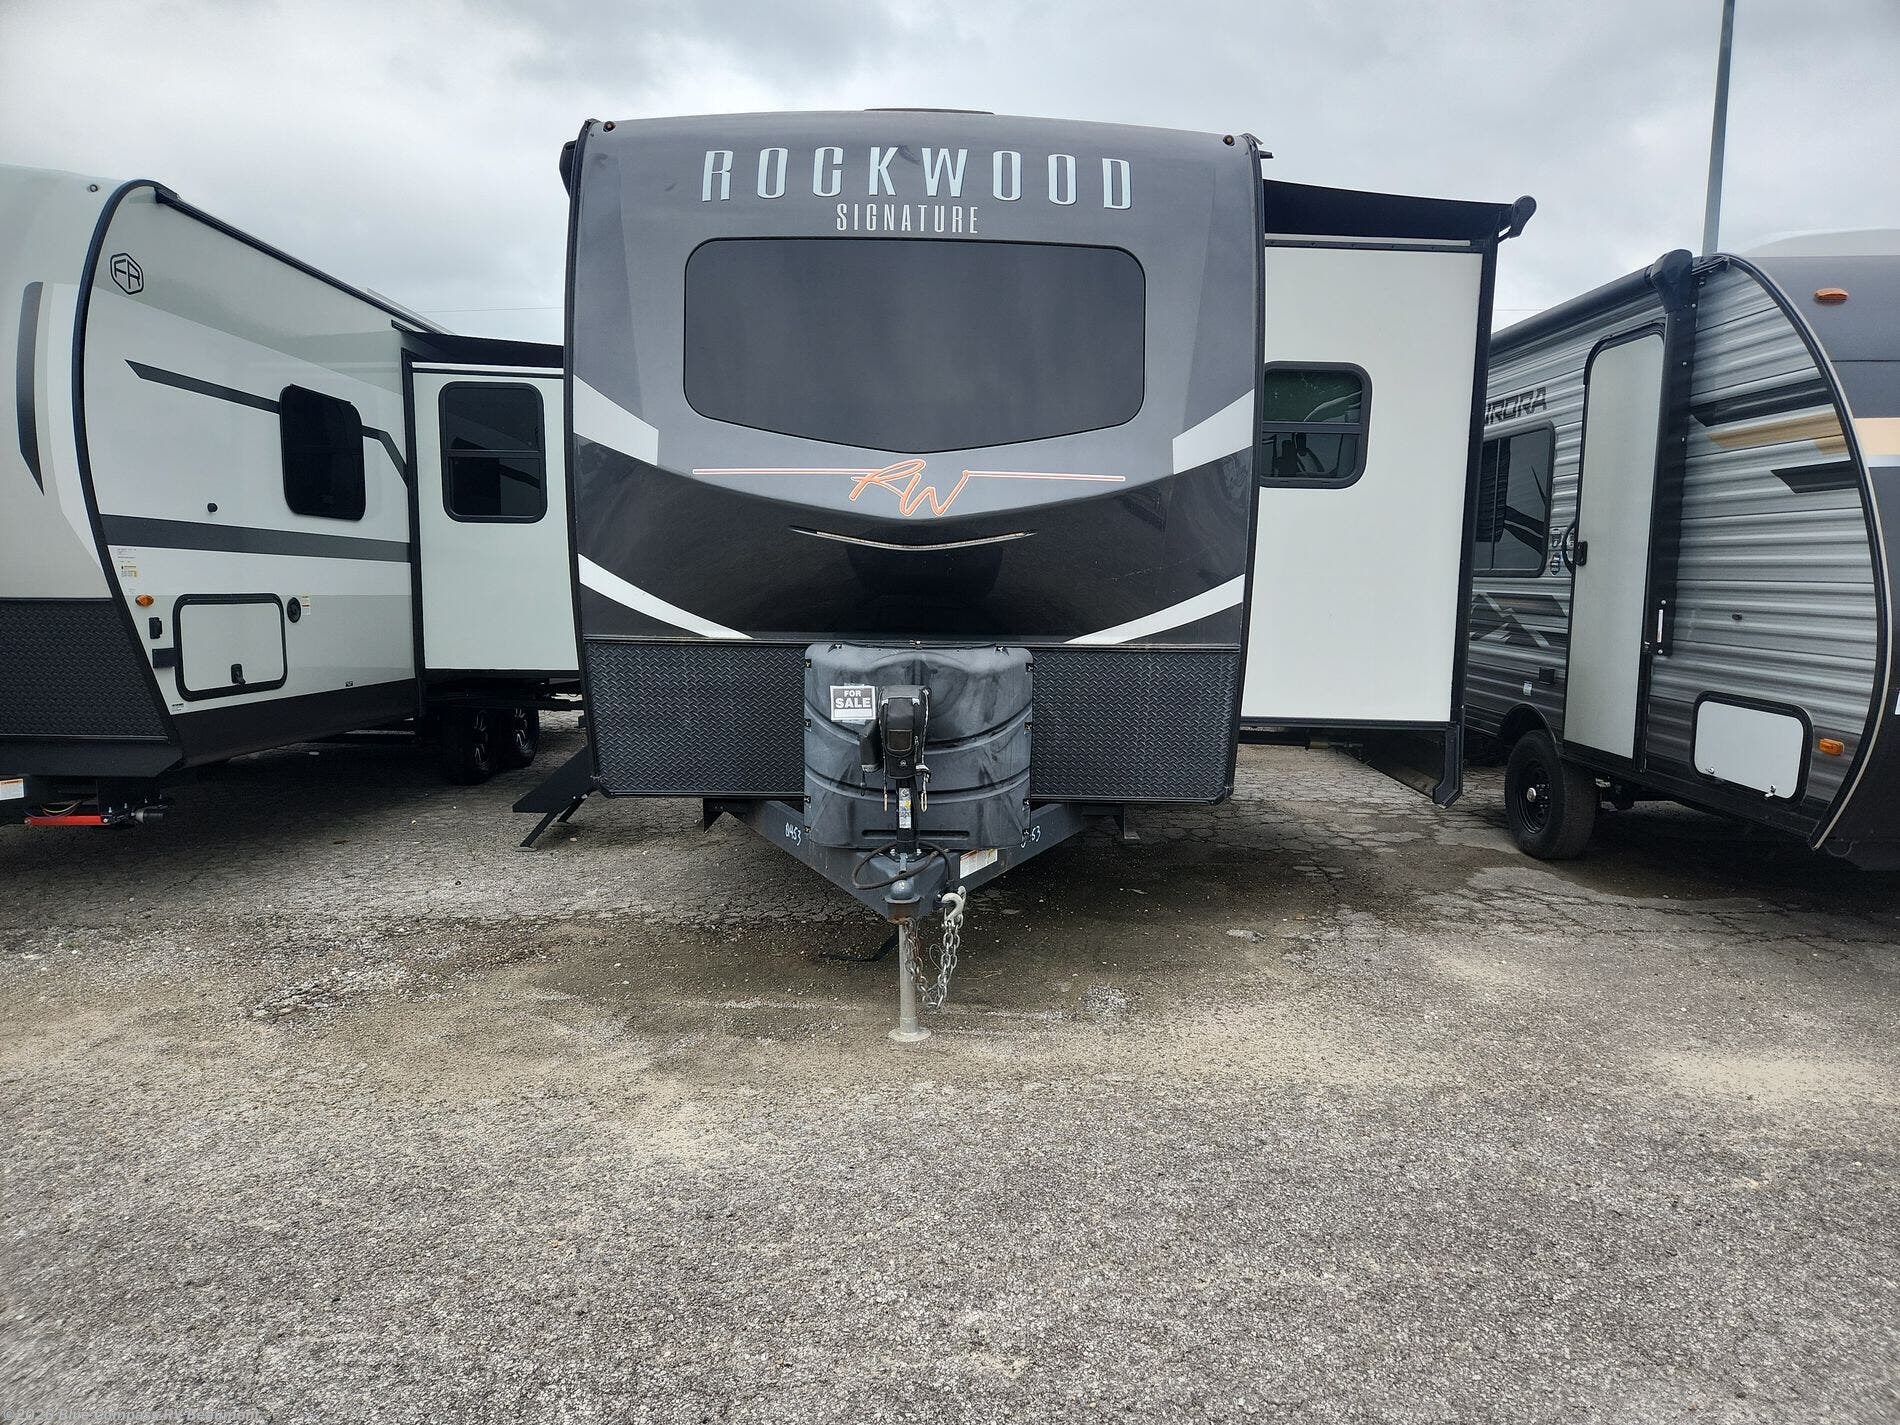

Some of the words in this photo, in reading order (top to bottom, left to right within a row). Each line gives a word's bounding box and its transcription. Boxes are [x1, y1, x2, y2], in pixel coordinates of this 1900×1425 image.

[702, 146, 1132, 210] ROCKWOOD
[836, 203, 978, 234] SIGNATURE
[113, 258, 141, 290] FR
[849, 459, 970, 516] RW
[834, 697, 872, 709] SALE
[843, 689, 862, 698] FOR
